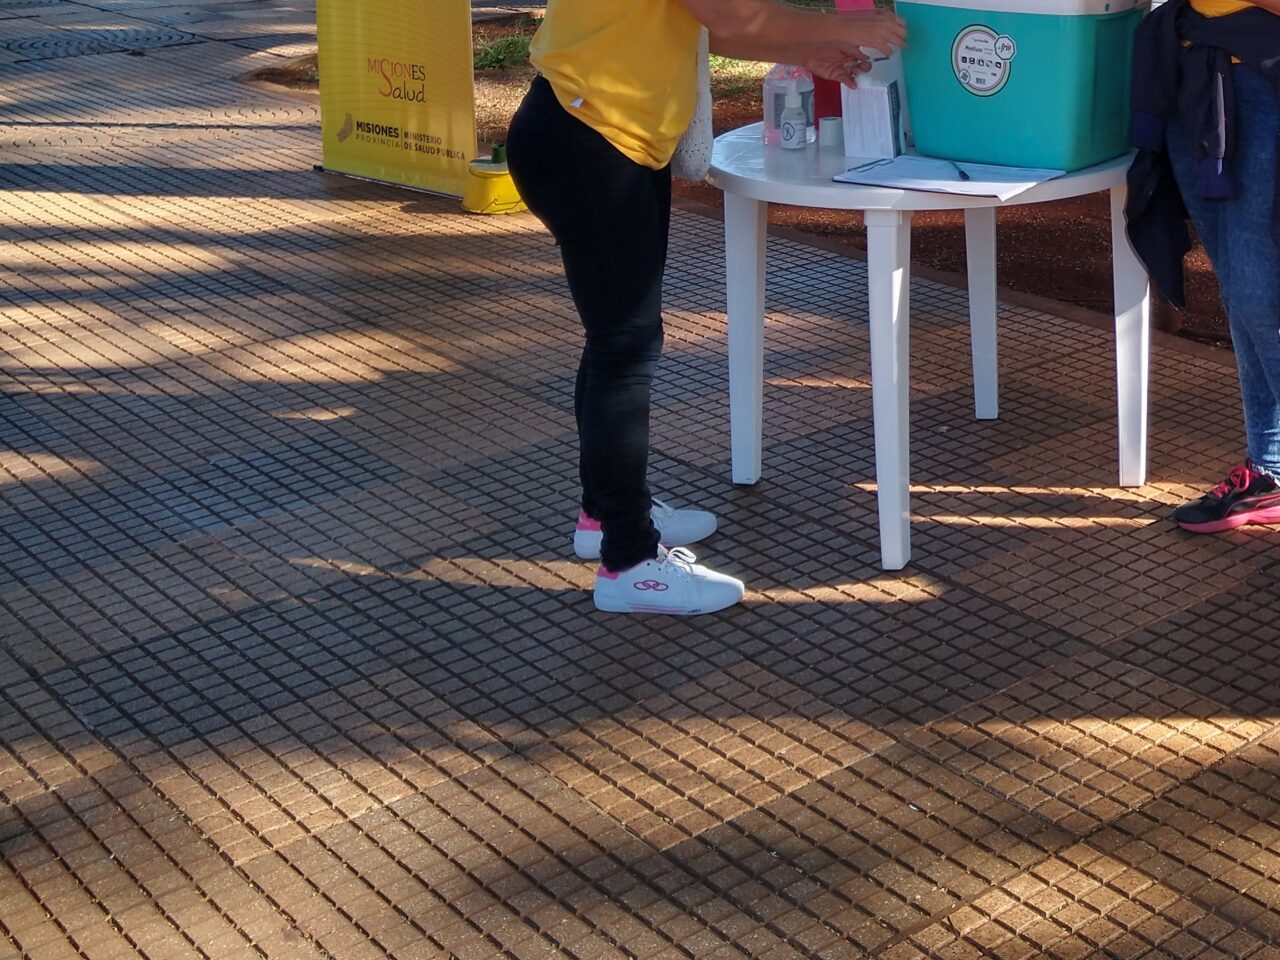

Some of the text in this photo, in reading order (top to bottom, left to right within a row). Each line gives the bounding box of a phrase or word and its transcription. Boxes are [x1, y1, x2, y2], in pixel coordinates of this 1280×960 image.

[356, 121, 400, 138] MISIONES
[356, 134, 400, 148] PROVINCIA
[404, 130, 442, 145] MINISTERIO
[404, 142, 413, 151] DE
[414, 144, 435, 155] SALUD
